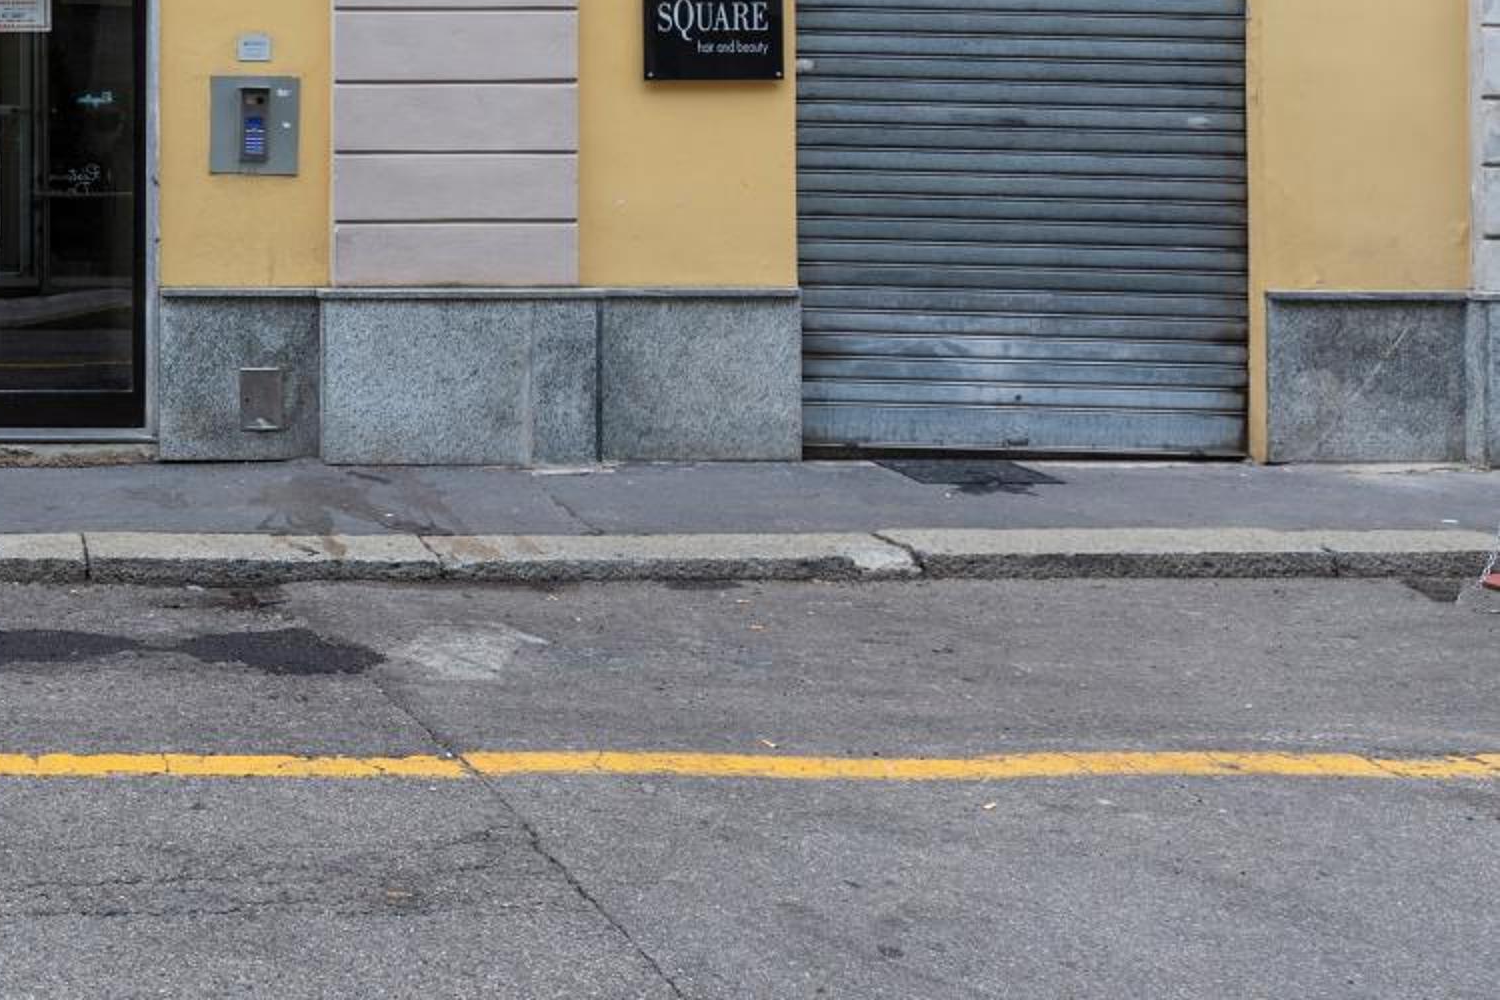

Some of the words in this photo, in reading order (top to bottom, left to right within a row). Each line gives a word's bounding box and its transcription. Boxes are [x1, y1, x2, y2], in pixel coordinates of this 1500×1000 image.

[697, 39, 714, 53] hair
[715, 39, 735, 53] and
[737, 39, 769, 54] beauty
